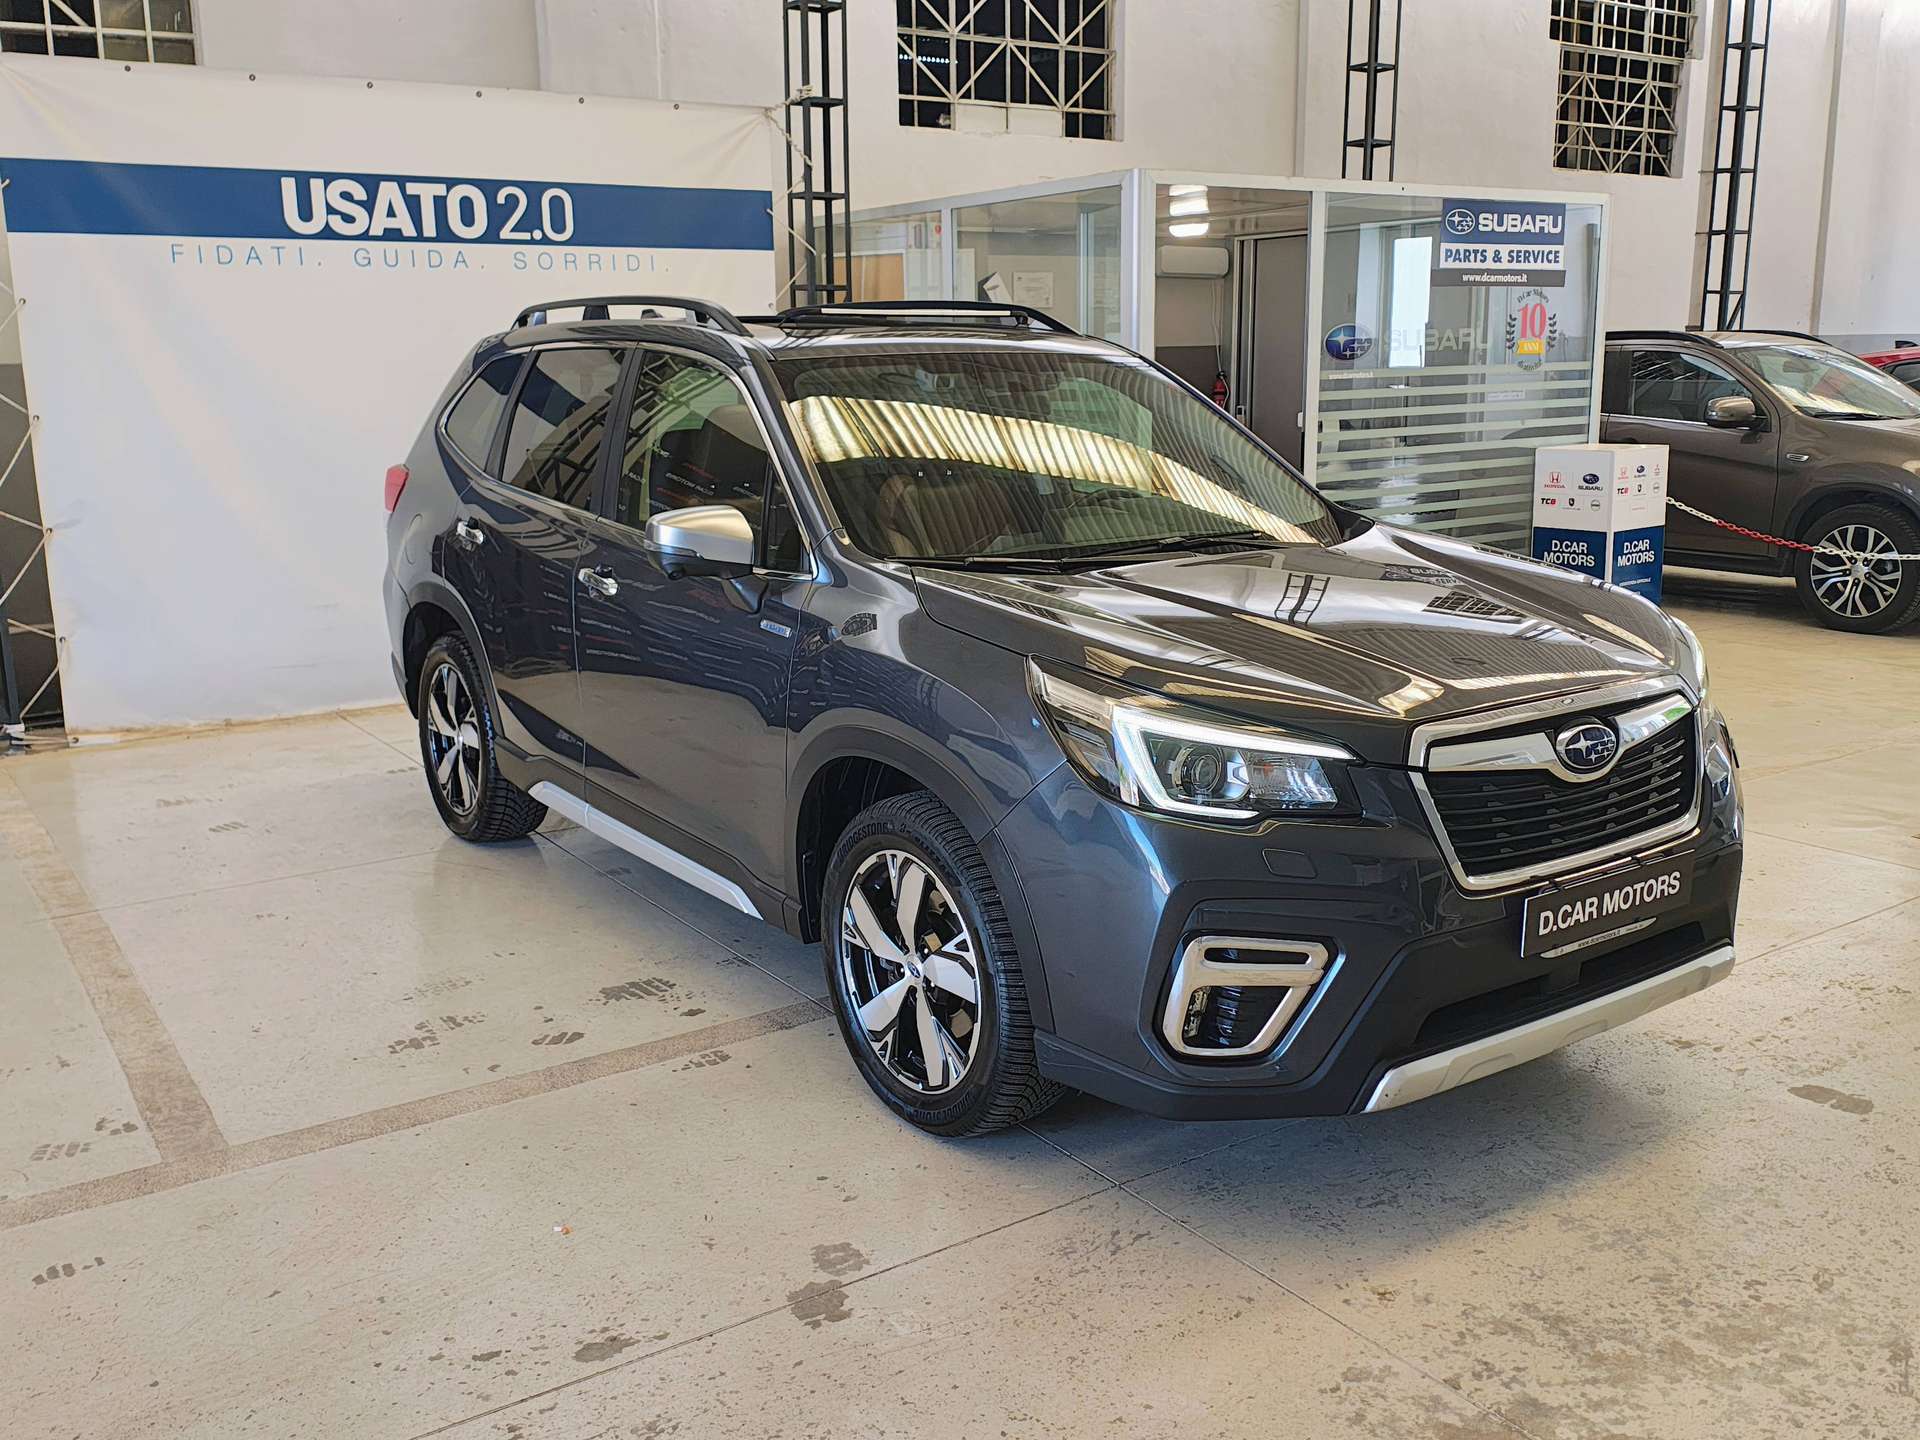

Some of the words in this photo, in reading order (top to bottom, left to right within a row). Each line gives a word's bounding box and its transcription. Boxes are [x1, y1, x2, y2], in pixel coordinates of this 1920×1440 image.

[281, 177, 488, 239] USATO
[496, 186, 574, 242] 2.0
[1478, 213, 1562, 234] SUBARU
[171, 243, 322, 266] FIDATI.
[353, 247, 485, 271] GUIDA.
[513, 250, 672, 273] SORRIDI.
[1444, 248, 1487, 263] PARTS
[1492, 249, 1502, 263] &
[1507, 250, 1560, 264] SERVICE
[1462, 272, 1528, 283] www.dcarmotors.it
[1518, 303, 1547, 338] 10
[1552, 540, 1588, 554] D.CAR
[1624, 540, 1650, 554] D.CAR
[1544, 552, 1595, 567] MOTORS
[1617, 551, 1655, 567] MOTORS
[1539, 896, 1599, 936] D.CAR
[1602, 871, 1680, 916] MOTORS
